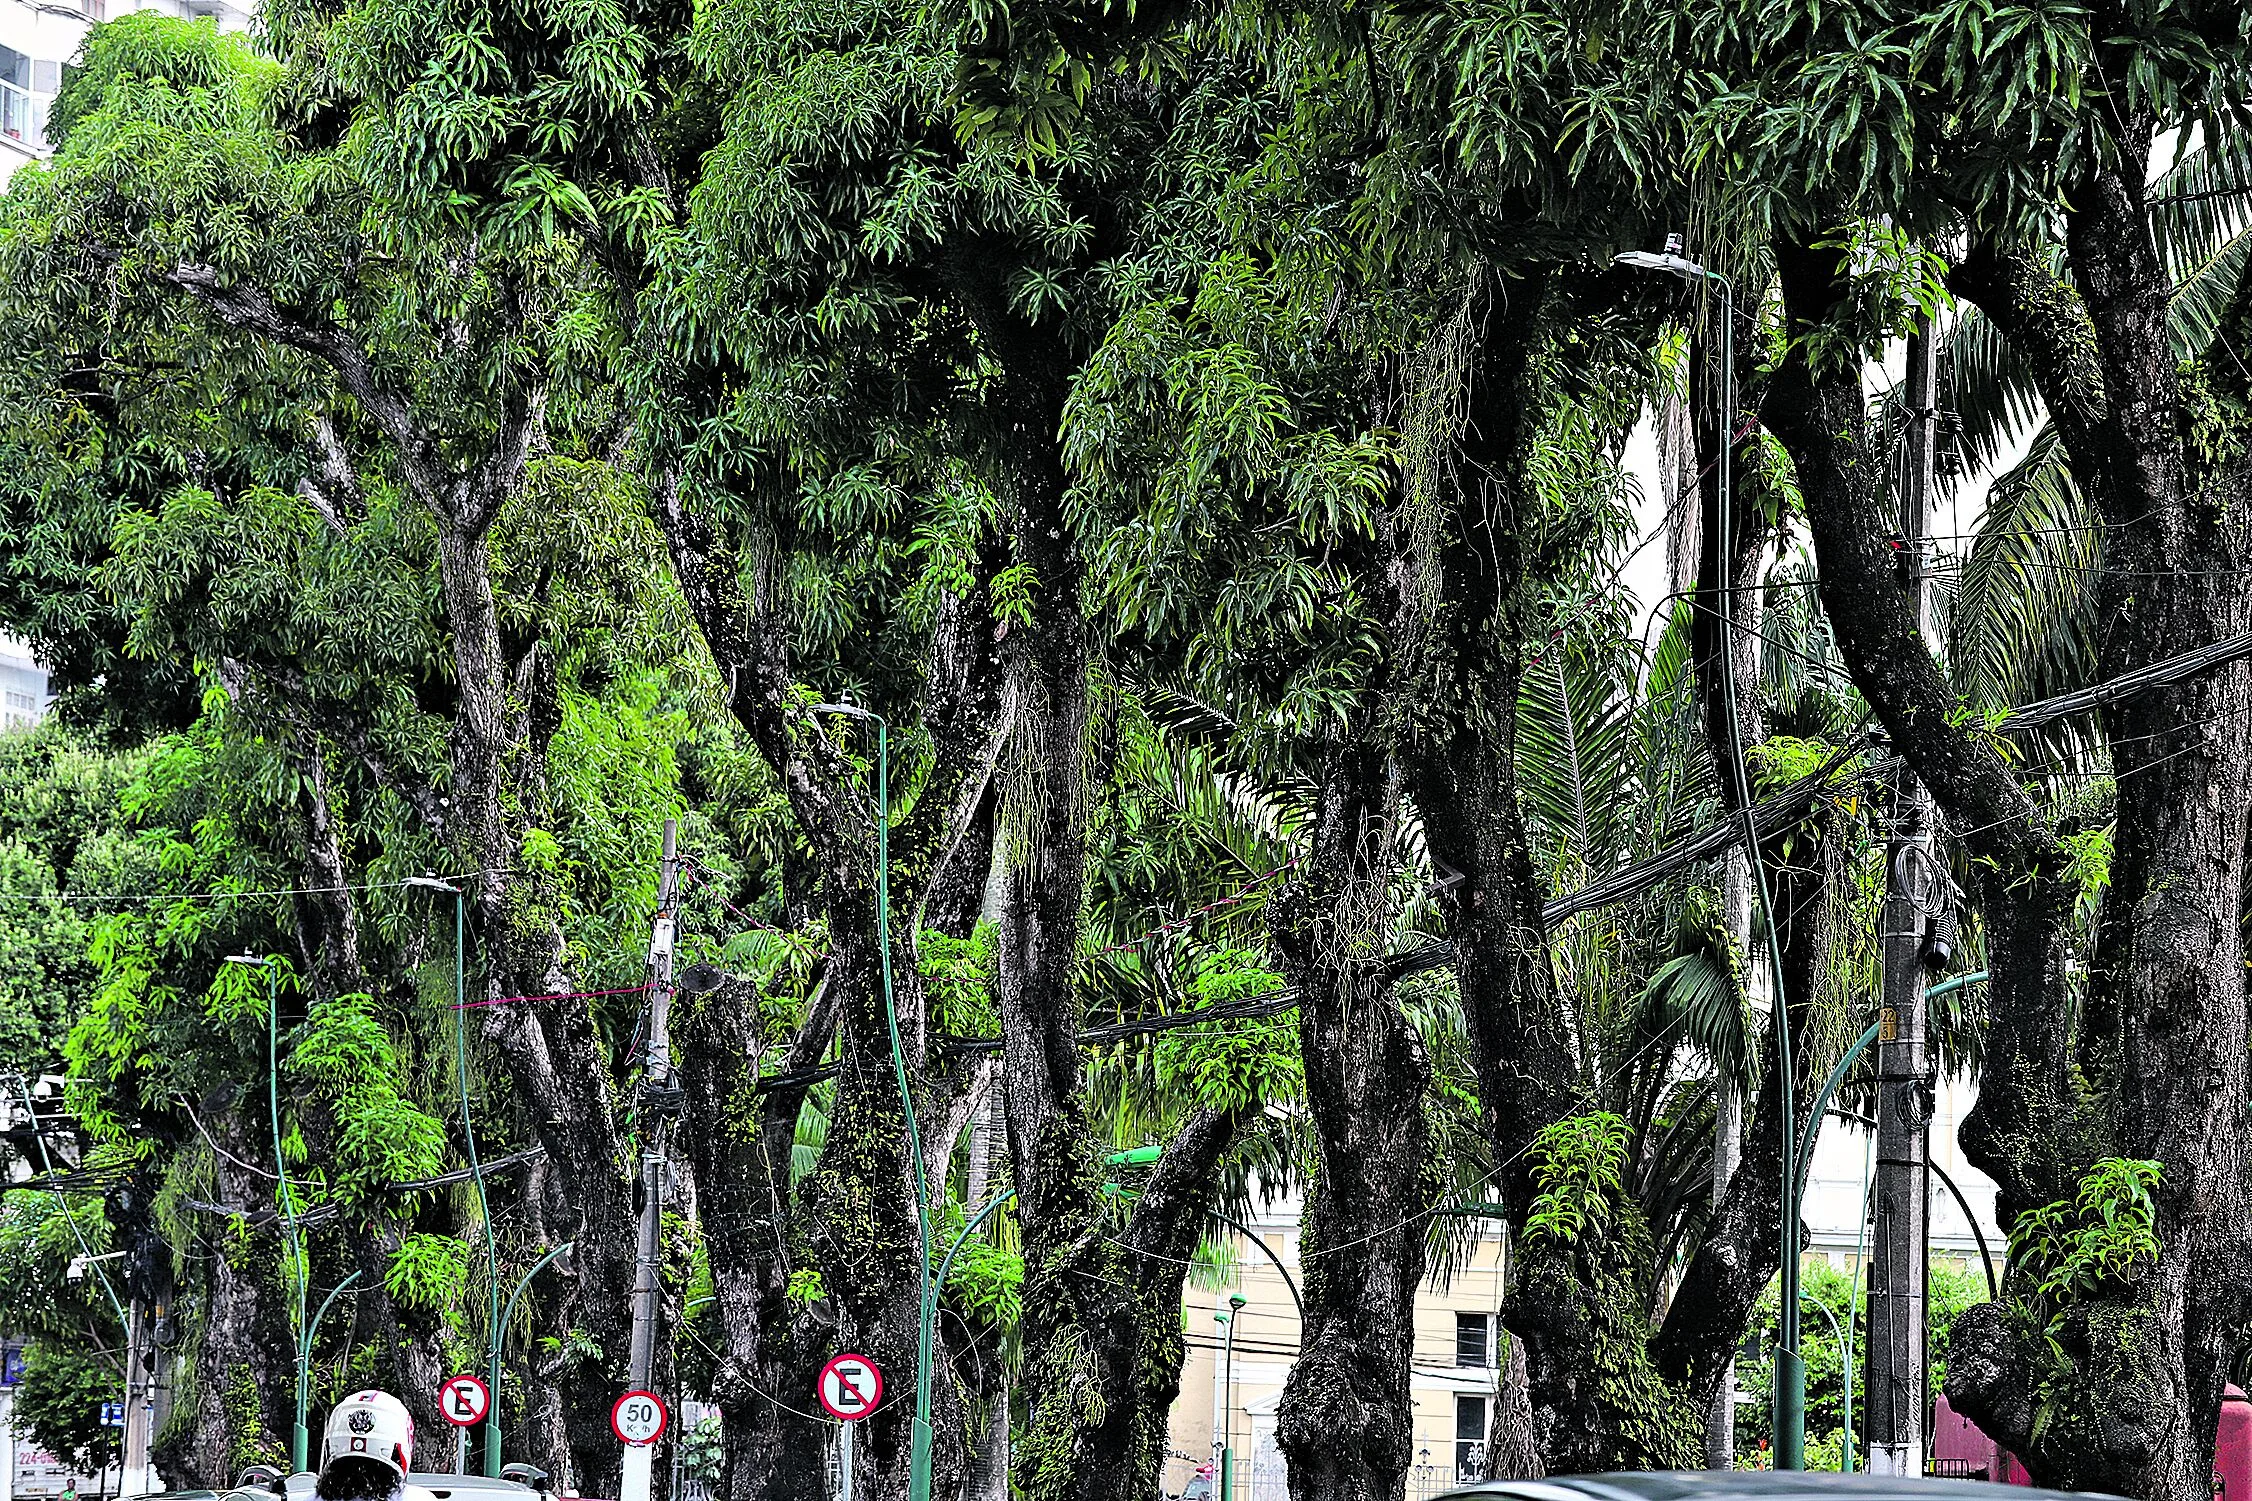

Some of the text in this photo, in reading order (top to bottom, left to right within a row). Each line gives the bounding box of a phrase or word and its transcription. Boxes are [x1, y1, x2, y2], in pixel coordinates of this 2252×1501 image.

[1882, 1009, 1894, 1022] 22
[838, 1368, 861, 1405] E
[454, 1386, 473, 1415] E
[627, 1404, 652, 1422] 50
[626, 1424, 650, 1432] K/h
